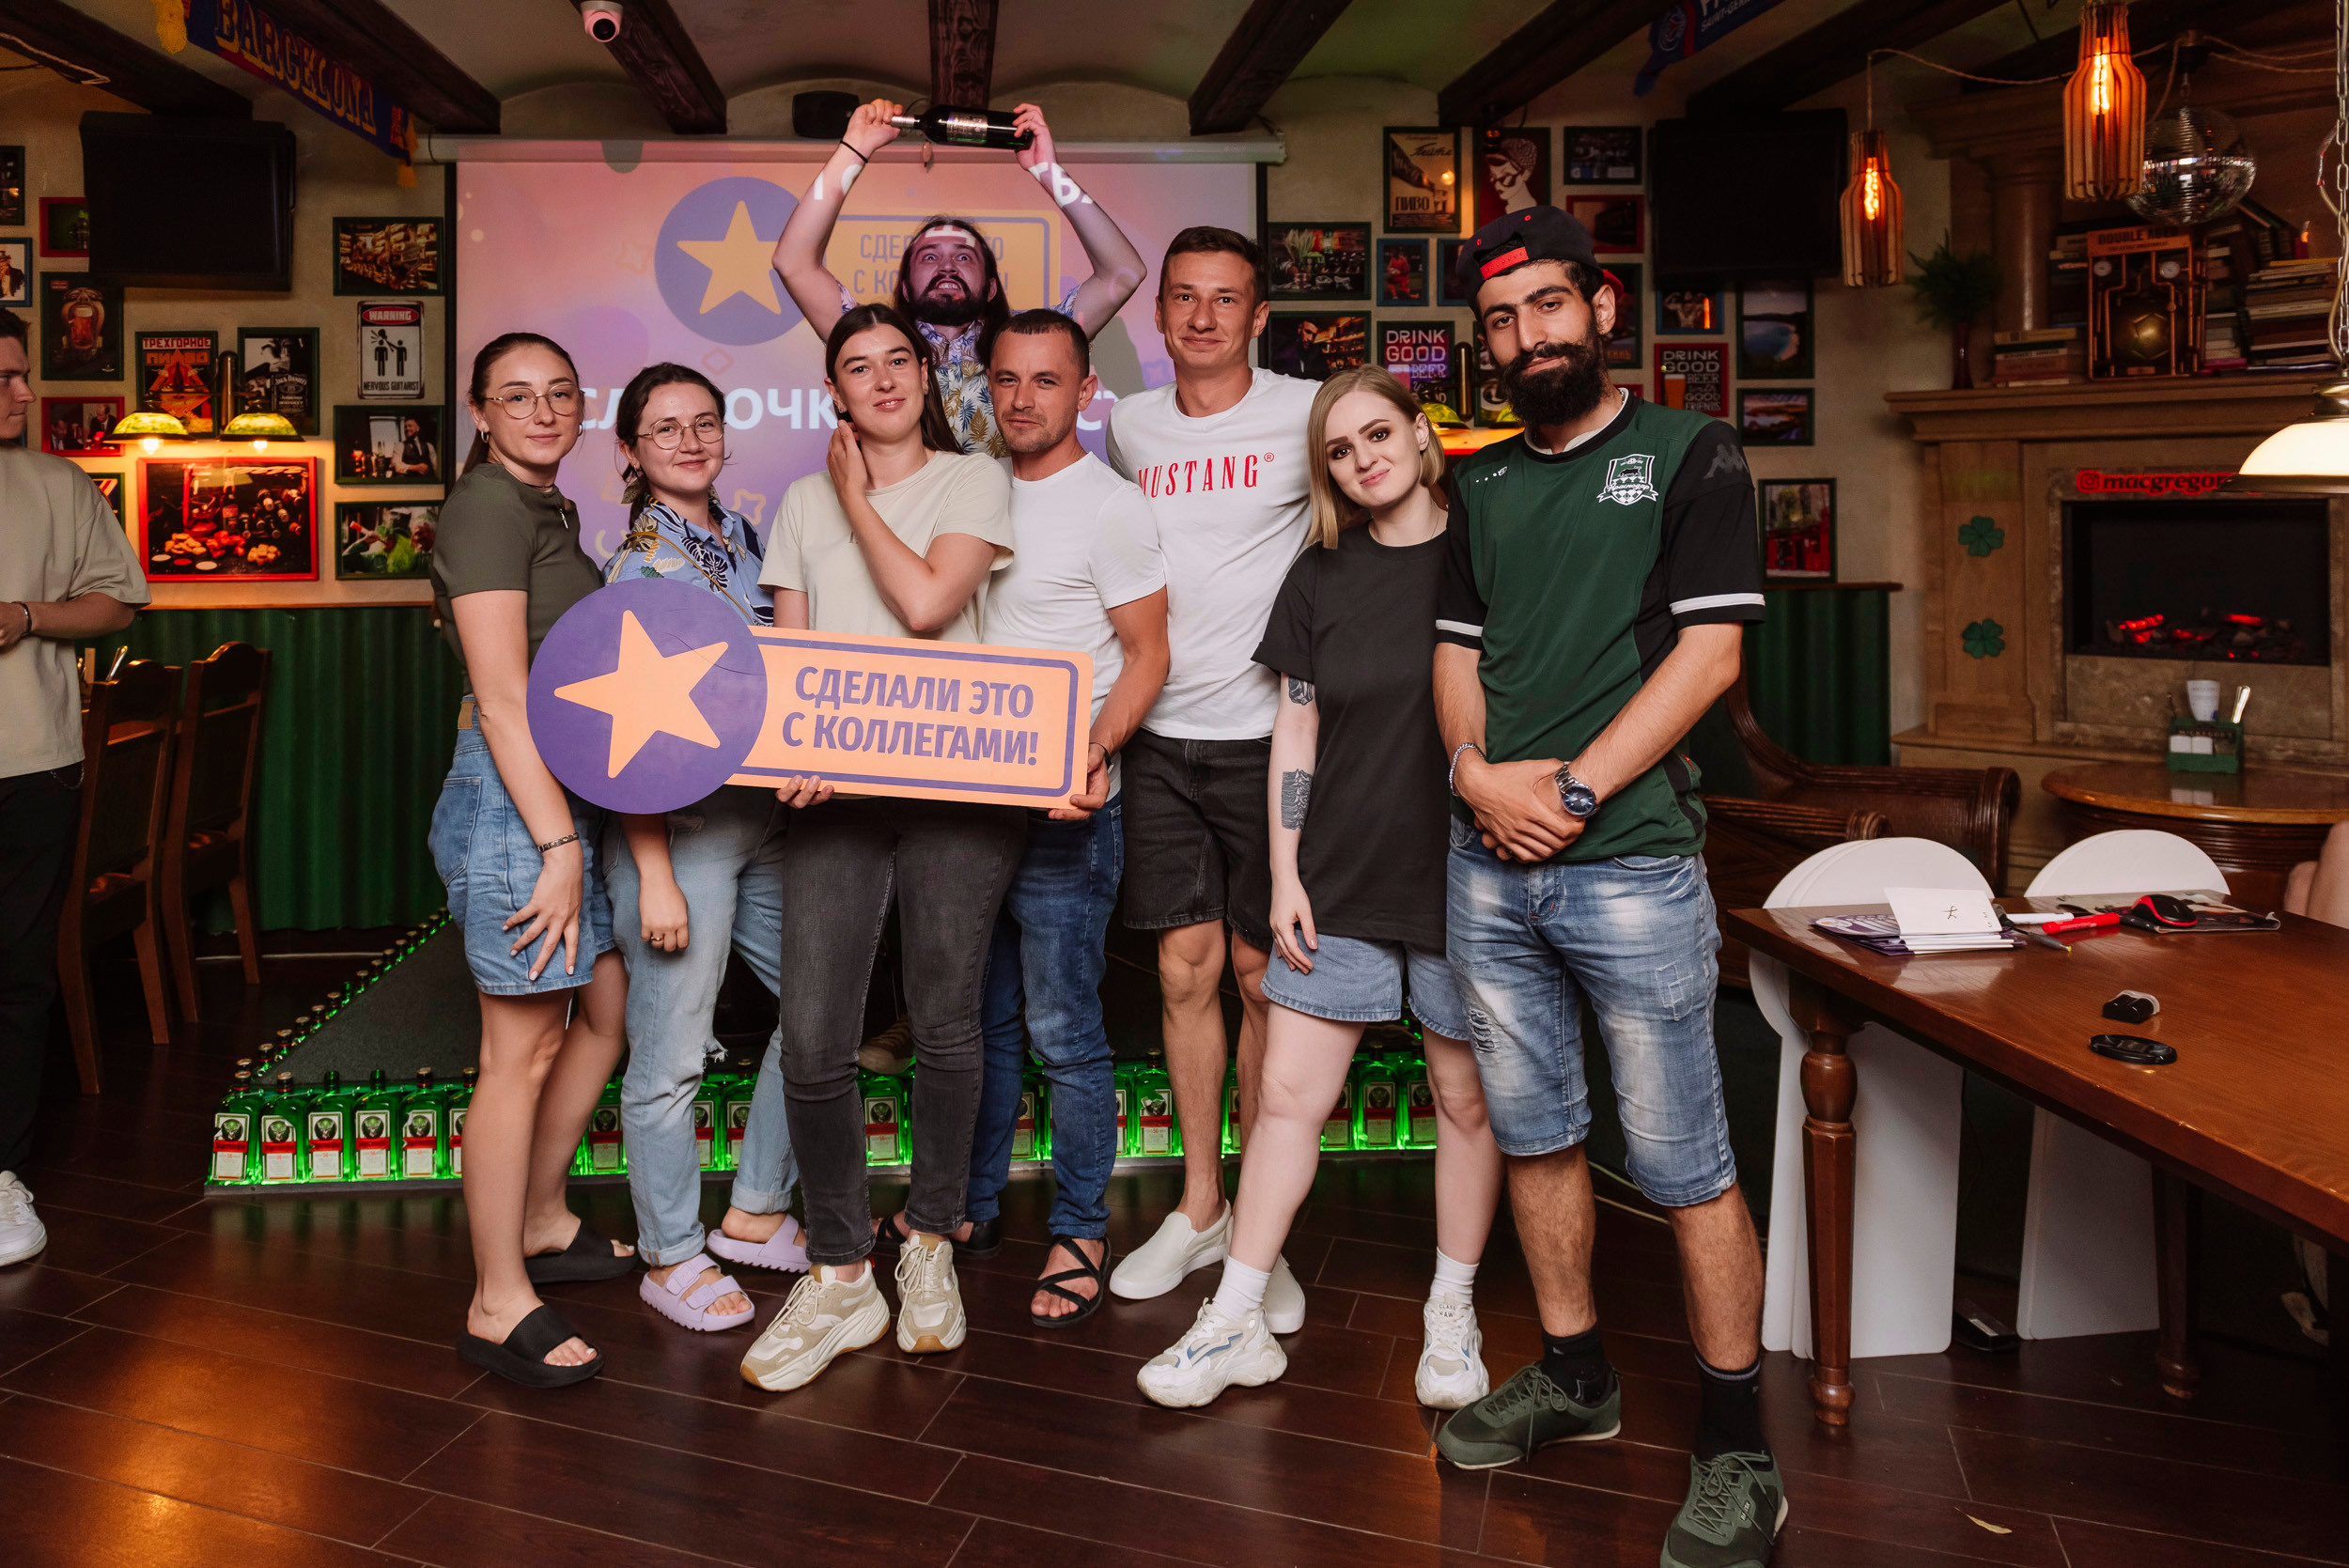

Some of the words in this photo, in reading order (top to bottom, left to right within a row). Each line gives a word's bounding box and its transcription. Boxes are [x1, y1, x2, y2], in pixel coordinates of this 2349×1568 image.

[215, 0, 377, 135] BARCELONA
[1395, 196, 1429, 210] ПИВО
[369, 310, 412, 320] WARNING
[144, 337, 210, 348] ТРЕХГОРНОЕ
[1386, 329, 1445, 344] DRINK
[1386, 346, 1446, 362] GOOD
[1663, 349, 1719, 361] DRINK
[1411, 364, 1447, 379] BEER
[1663, 361, 1719, 373] GOOD
[1687, 374, 1719, 383] BEER
[364, 381, 389, 391] NERVOUS
[391, 381, 419, 391] GUITARIST
[1686, 392, 1720, 401] GOOD
[2103, 475, 2226, 493] macgregor
[795, 665, 960, 712] СДЕЛАЛИ
[968, 680, 1034, 719] ЭТО
[782, 711, 805, 747] С
[813, 714, 1039, 767] КОЛЛЕГАМИ!
